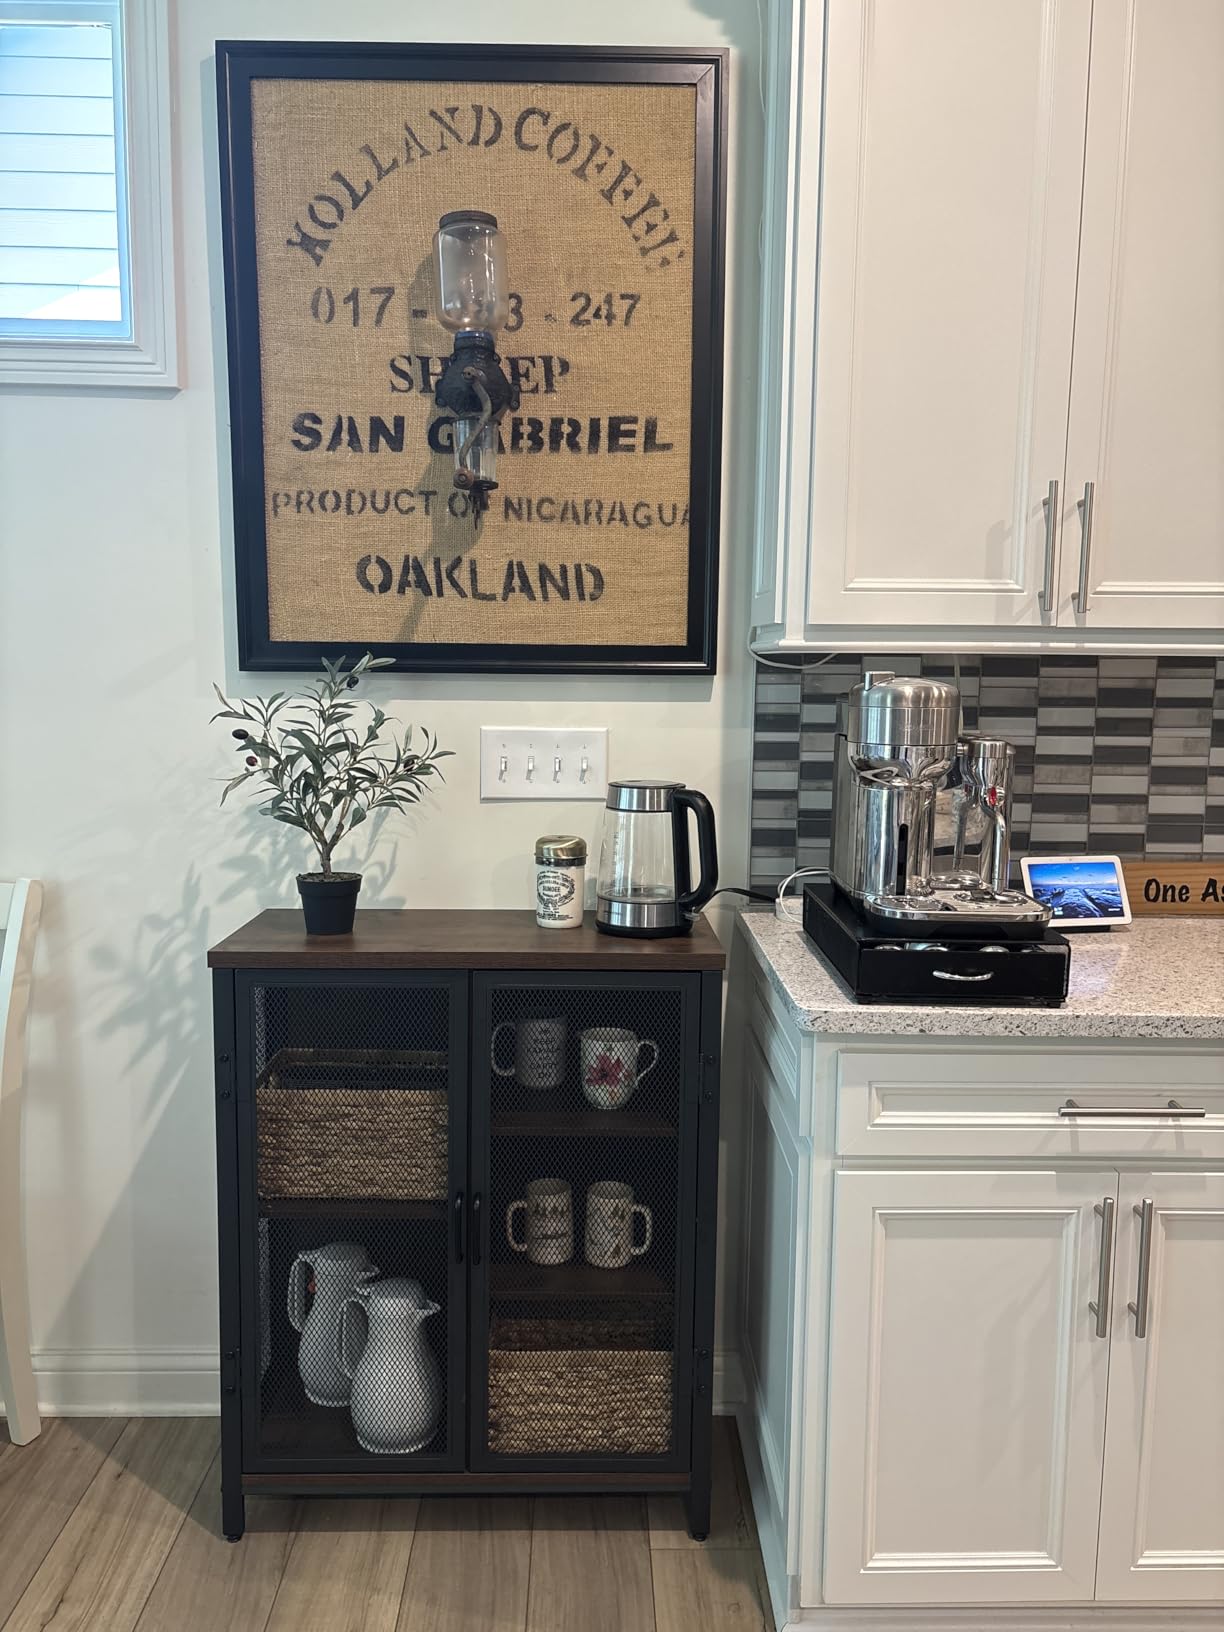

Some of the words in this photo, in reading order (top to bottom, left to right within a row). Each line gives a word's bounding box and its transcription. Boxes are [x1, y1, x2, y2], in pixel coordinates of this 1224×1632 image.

[286, 104, 502, 267] HOLLAND
[310, 286, 395, 327] 017
[570, 292, 641, 327] 247
[389, 355, 570, 394] SHEP
[291, 413, 405, 453] SAN
[428, 415, 673, 454] GBRIEL
[271, 490, 438, 518] PRODUCT
[356, 554, 605, 602] OAKLAND
[1144, 878, 1190, 903] One
